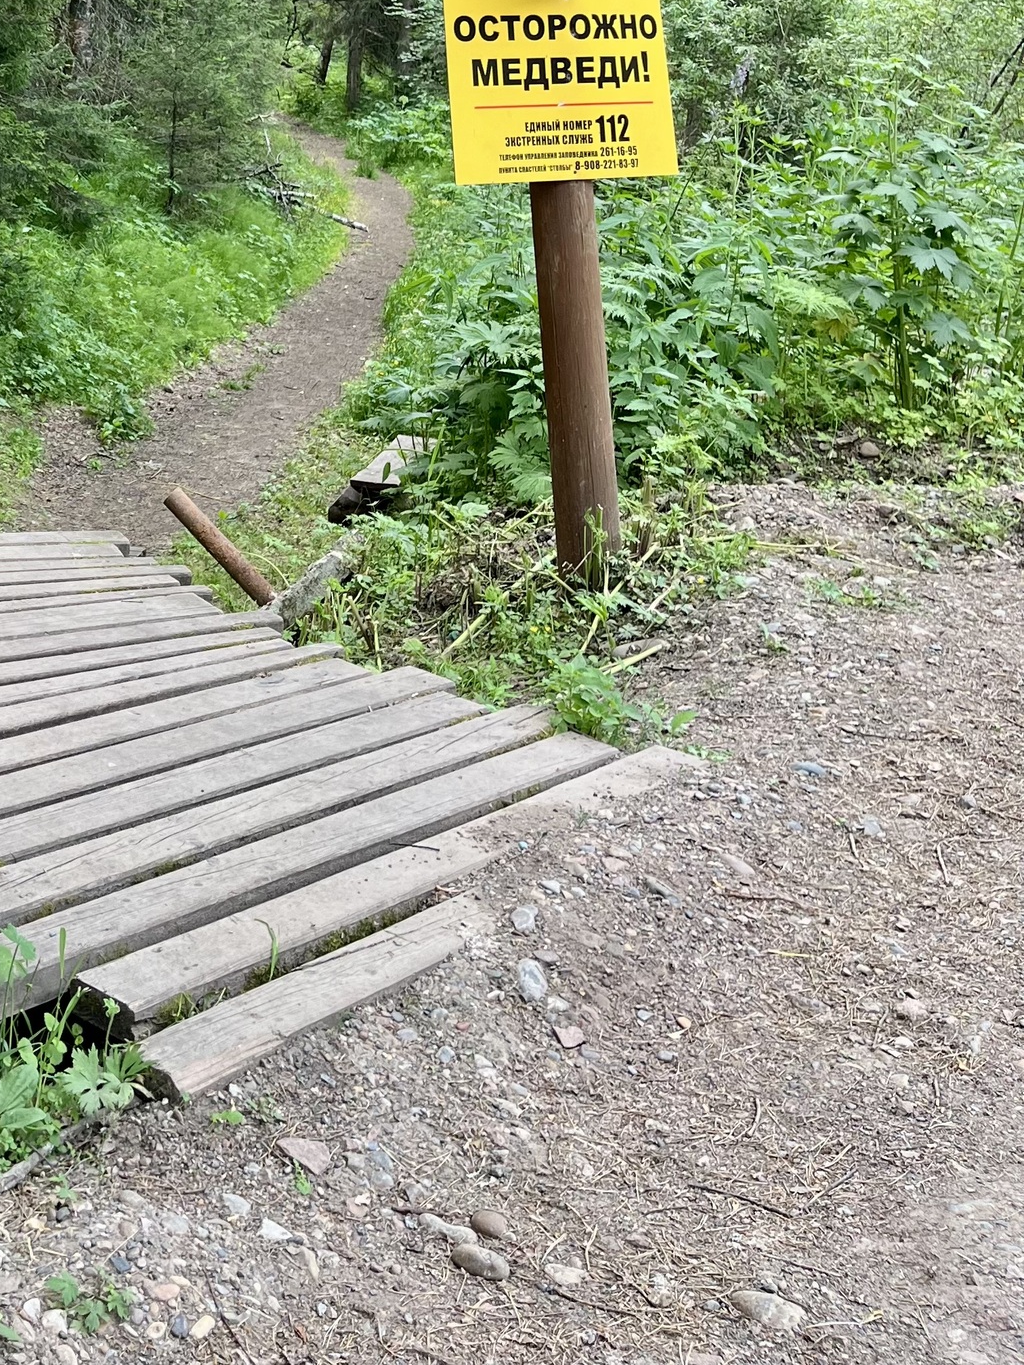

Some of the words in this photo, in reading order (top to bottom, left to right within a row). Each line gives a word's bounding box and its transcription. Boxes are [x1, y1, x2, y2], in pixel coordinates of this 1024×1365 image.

[453, 14, 658, 41] ОСТОРОЖНО
[471, 51, 651, 91] МЕДВЕДИ!
[525, 119, 561, 133] ЕДИНЫЙ
[562, 119, 593, 131] НОМЕР
[595, 114, 630, 142] 112
[505, 136, 560, 147] ЭКСТРЕННЫХ
[562, 134, 594, 146] СЛУЖБ
[499, 153, 523, 161] ТЕЛЕФОН
[524, 152, 557, 160] УПРАВЛЕНИЯ
[558, 150, 598, 159] ЗАПОВЕДНИКА
[600, 146, 638, 157] 261-16-95
[574, 158, 639, 171] 8-908-221-83-97
